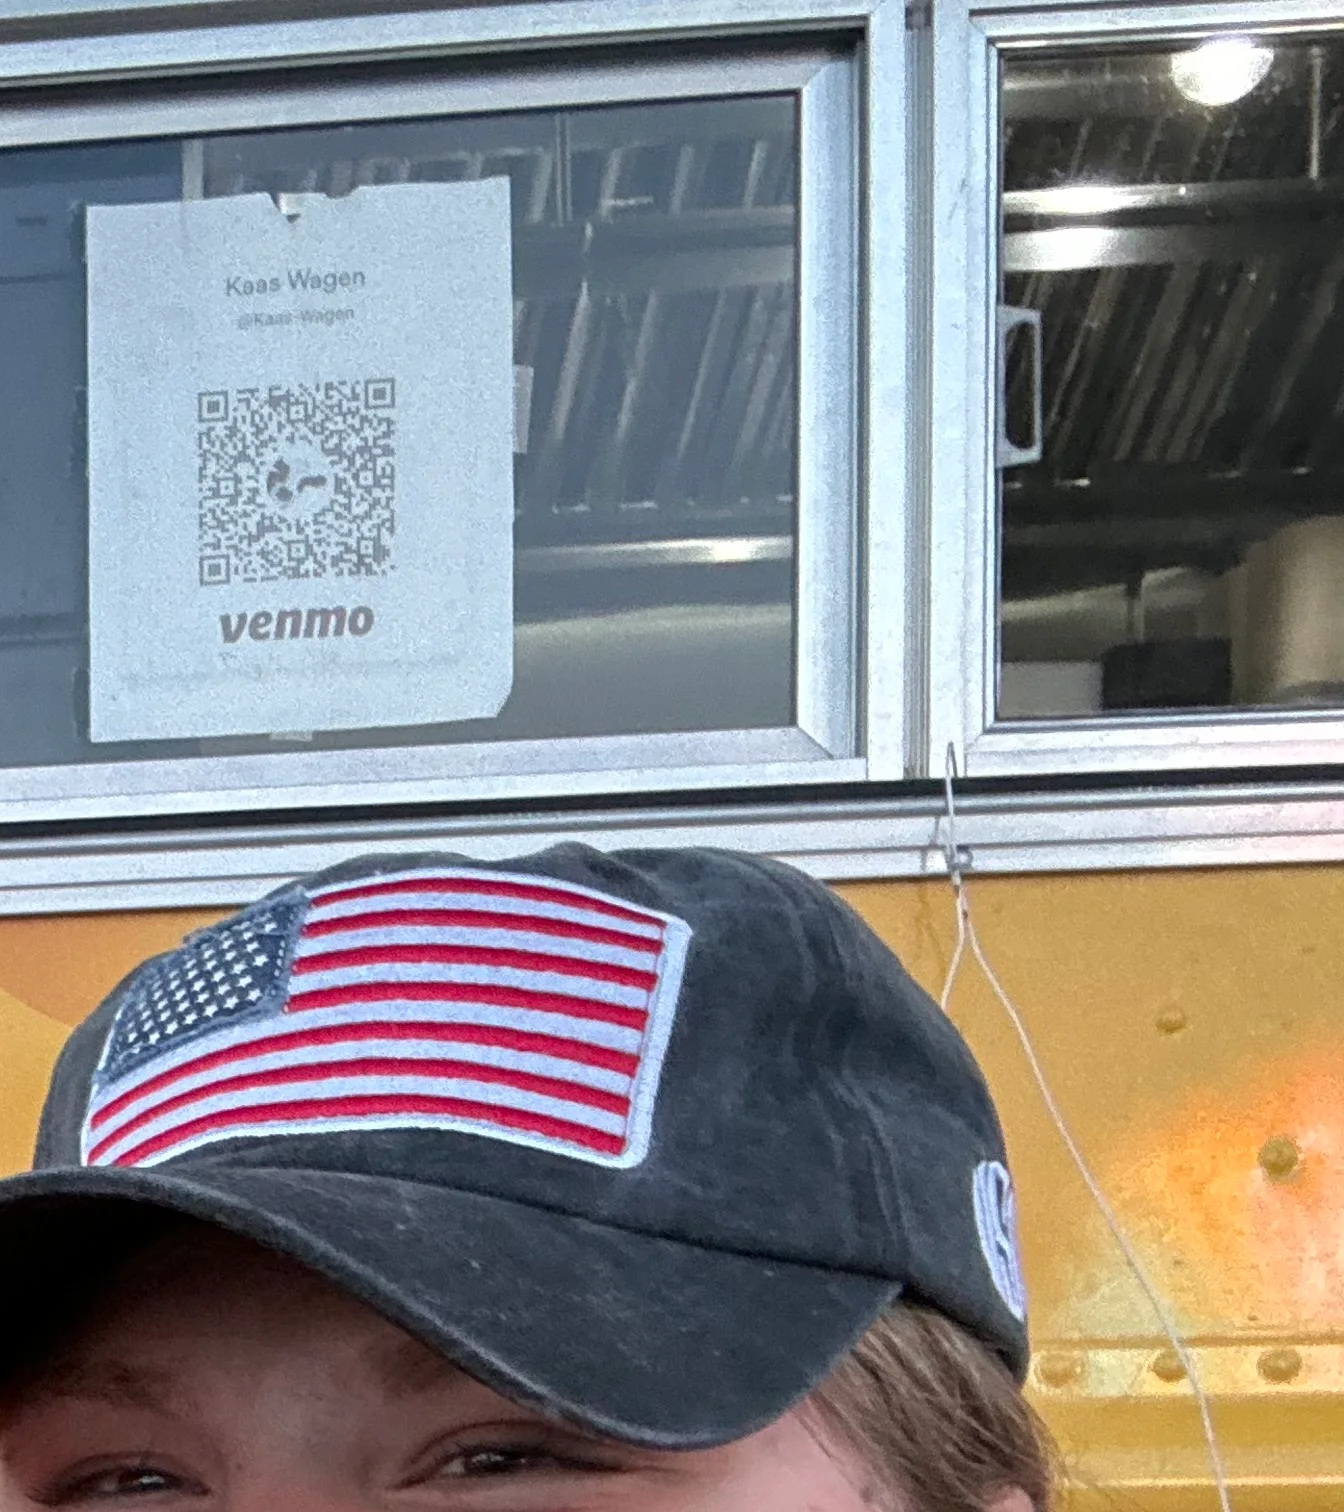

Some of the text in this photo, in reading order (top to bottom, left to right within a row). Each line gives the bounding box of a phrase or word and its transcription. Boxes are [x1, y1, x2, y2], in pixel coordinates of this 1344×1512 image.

[224, 267, 366, 297] Kaas Wagen
[220, 603, 375, 645] venmo
